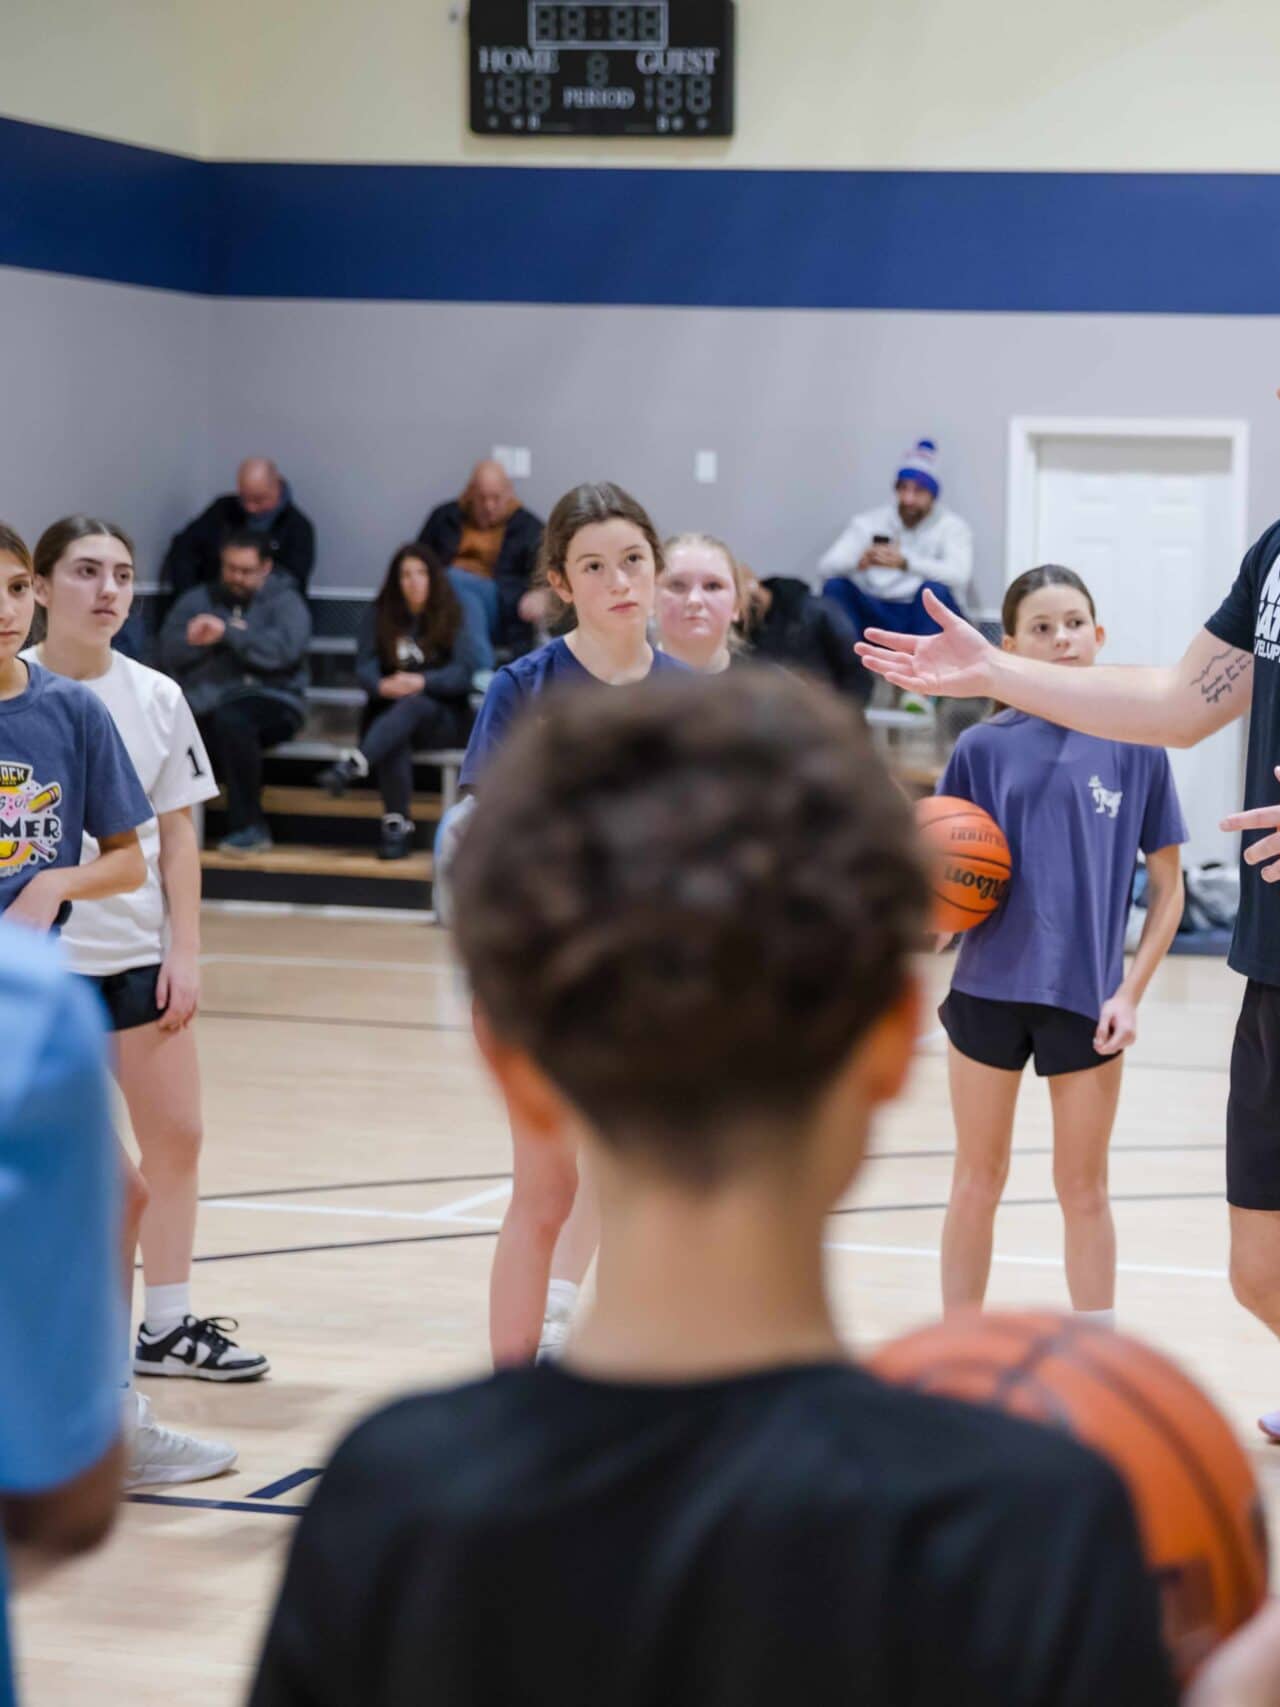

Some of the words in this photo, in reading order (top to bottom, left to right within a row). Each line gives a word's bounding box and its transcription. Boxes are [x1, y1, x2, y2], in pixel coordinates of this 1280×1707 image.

[478, 46, 559, 74] HOME
[636, 47, 719, 75] GUEST
[563, 86, 635, 109] PERIOD
[187, 747, 203, 777] 1
[0, 816, 60, 839] MER
